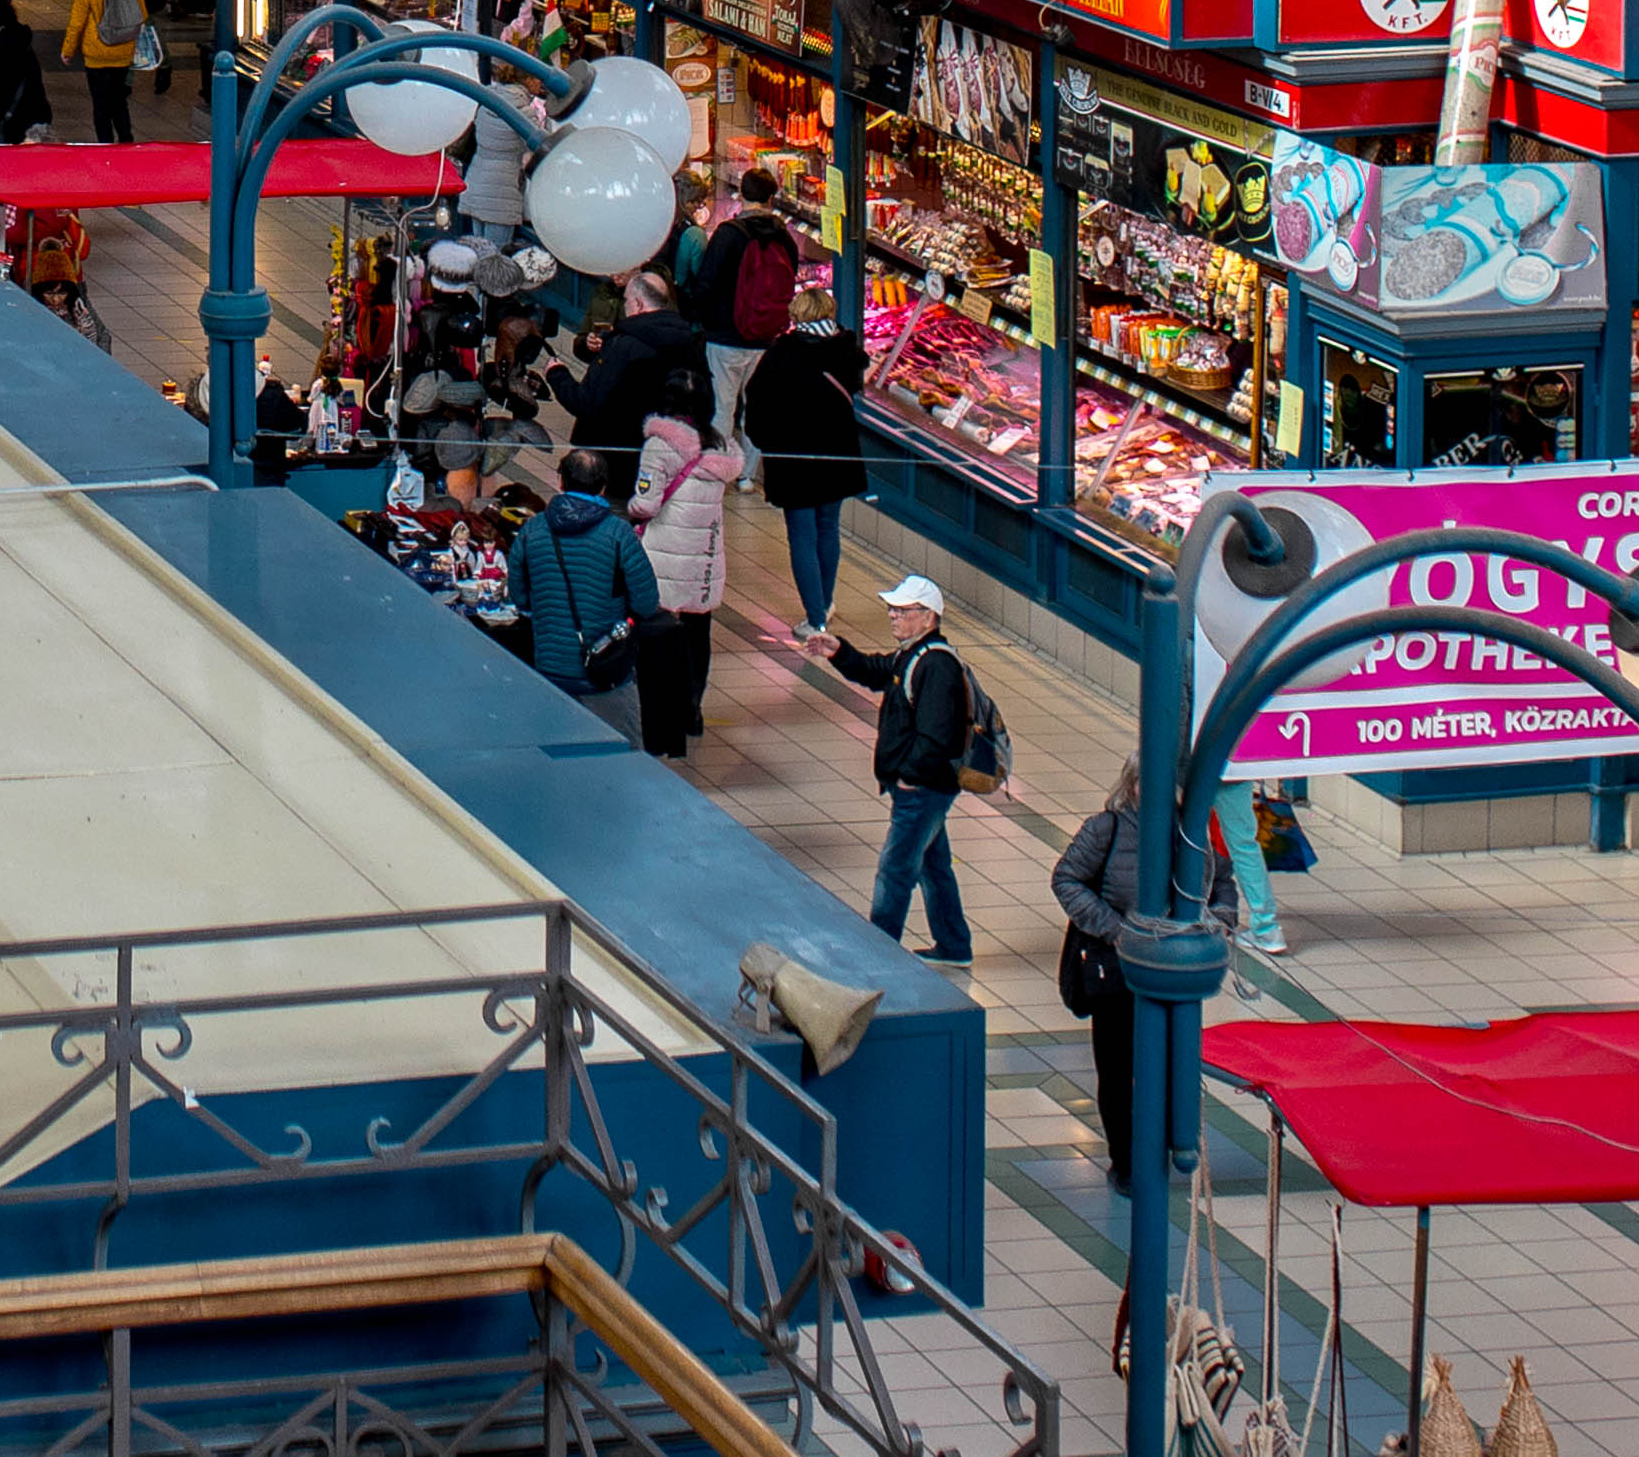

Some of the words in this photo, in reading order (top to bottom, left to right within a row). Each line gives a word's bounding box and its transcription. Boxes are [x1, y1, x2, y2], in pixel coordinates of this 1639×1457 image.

[1387, 12, 1428, 29] KFT.
[1211, 115, 1238, 138] GOLD
[1356, 716, 1403, 744] 100
[1410, 706, 1497, 743] MÉTER,
